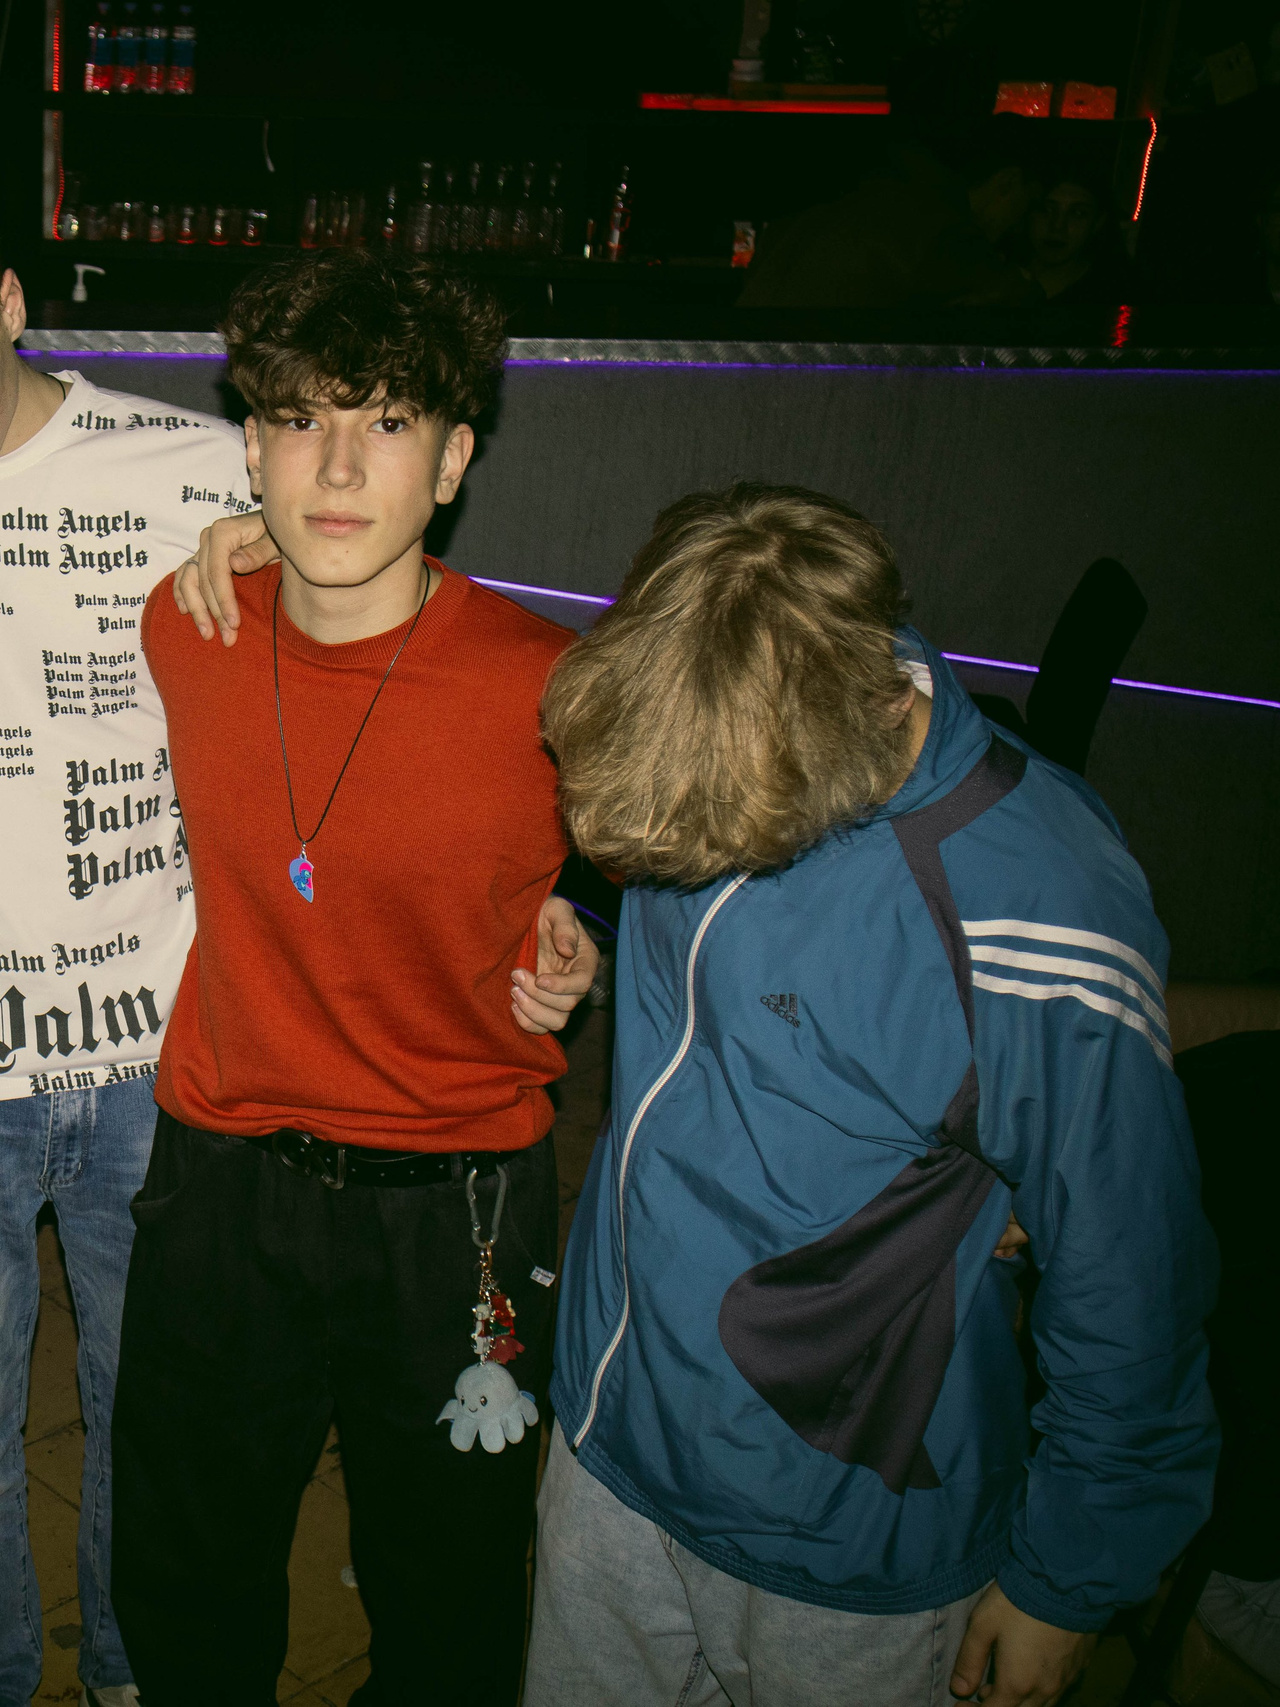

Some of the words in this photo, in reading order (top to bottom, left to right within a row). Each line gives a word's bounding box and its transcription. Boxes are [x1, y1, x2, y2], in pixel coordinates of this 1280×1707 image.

[181, 485, 220, 503] Palm
[223, 490, 257, 513] Ange
[57, 507, 147, 539] Angels
[58, 543, 149, 575] Angels
[74, 593, 108, 609] Palm
[112, 593, 149, 609] Angel
[97, 616, 136, 634] Palm
[42, 649, 82, 666] Palm
[87, 651, 135, 668] Angels
[43, 668, 83, 684] Palm
[88, 669, 136, 684] Angels
[45, 685, 85, 700] Palm
[89, 685, 136, 700] Angels
[47, 702, 87, 718] Palm
[66, 758, 145, 796] Palm
[63, 794, 161, 847] Palm
[66, 844, 167, 901] Palm
[176, 880, 194, 902] Pal
[50, 932, 141, 977] Angels
[760, 994, 801, 1029] adidas
[28, 1069, 97, 1096] Palm
